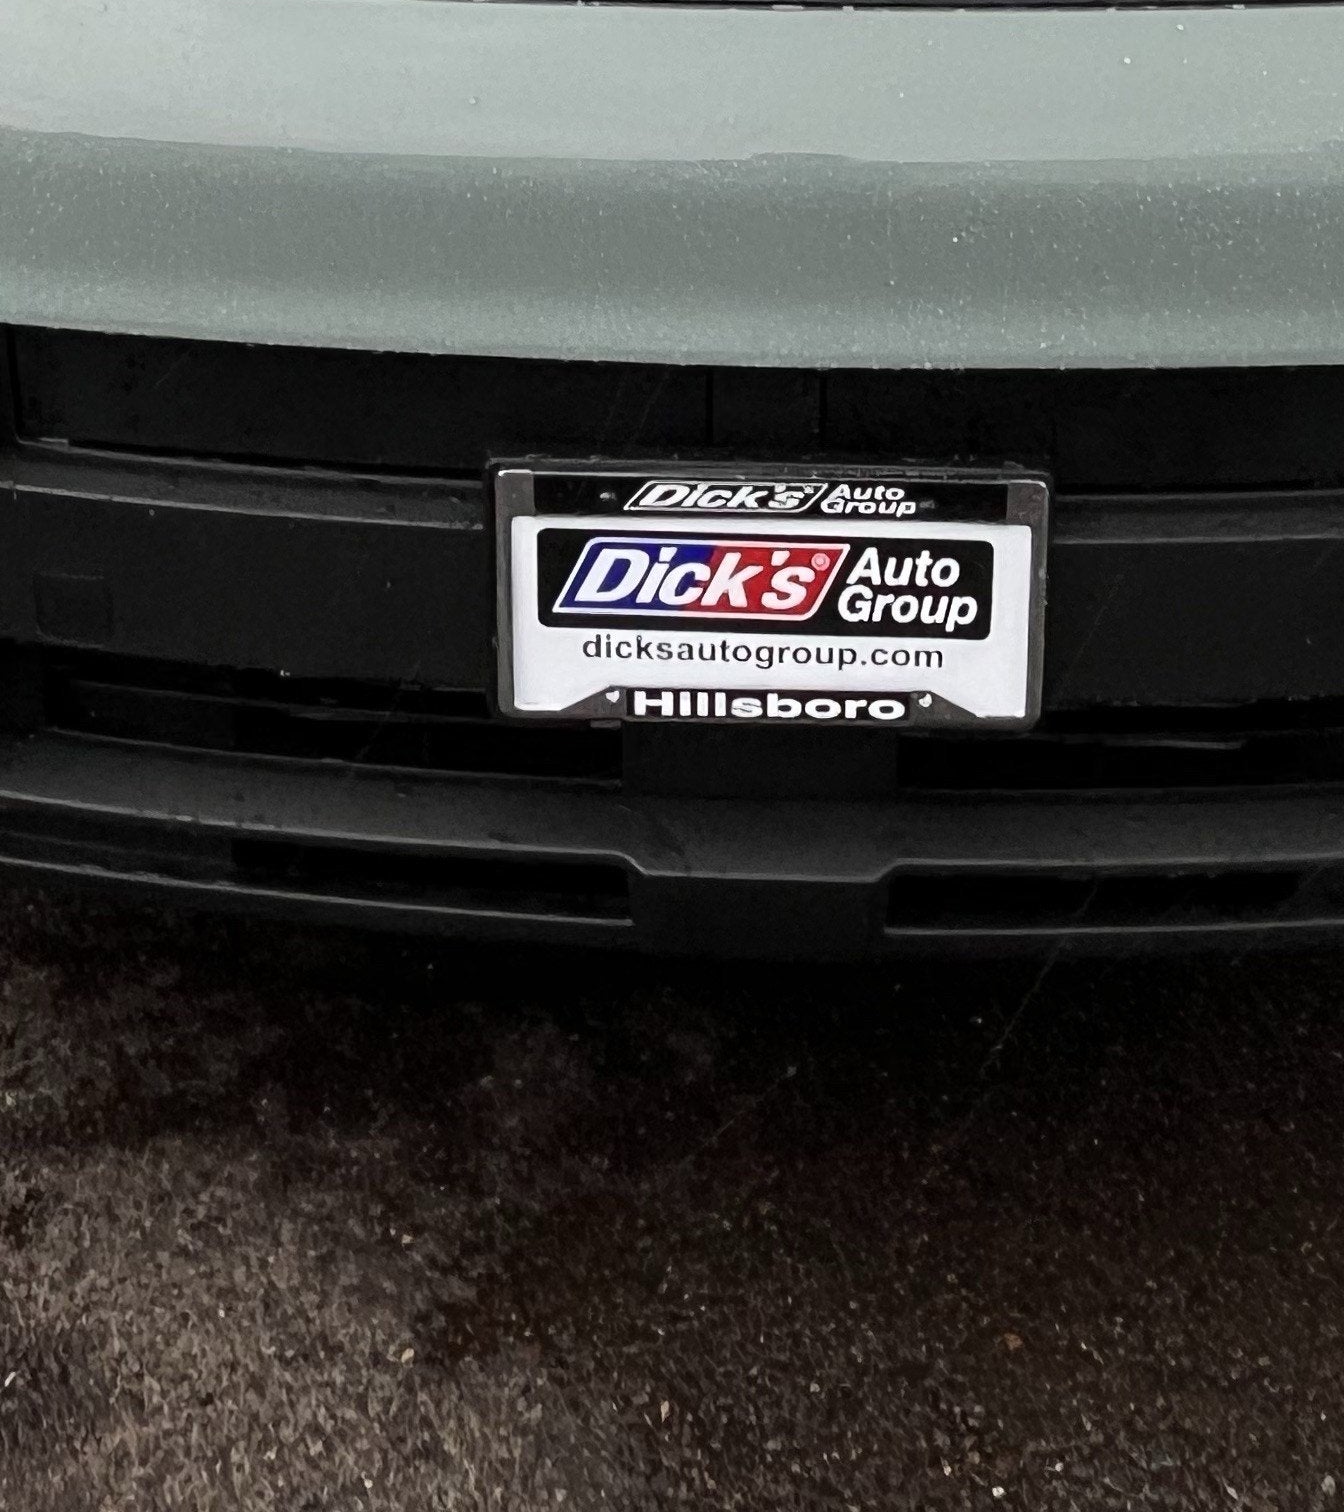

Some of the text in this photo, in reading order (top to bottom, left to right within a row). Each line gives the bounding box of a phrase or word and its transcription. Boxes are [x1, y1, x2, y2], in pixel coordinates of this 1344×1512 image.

[820, 497, 917, 517] Group
[828, 483, 906, 500] Auto
[574, 546, 816, 610] Dick's
[847, 547, 960, 588] Auto
[837, 586, 978, 632] Group
[582, 634, 944, 670] dicksautogroup.com
[634, 691, 906, 719] Hillsboro
